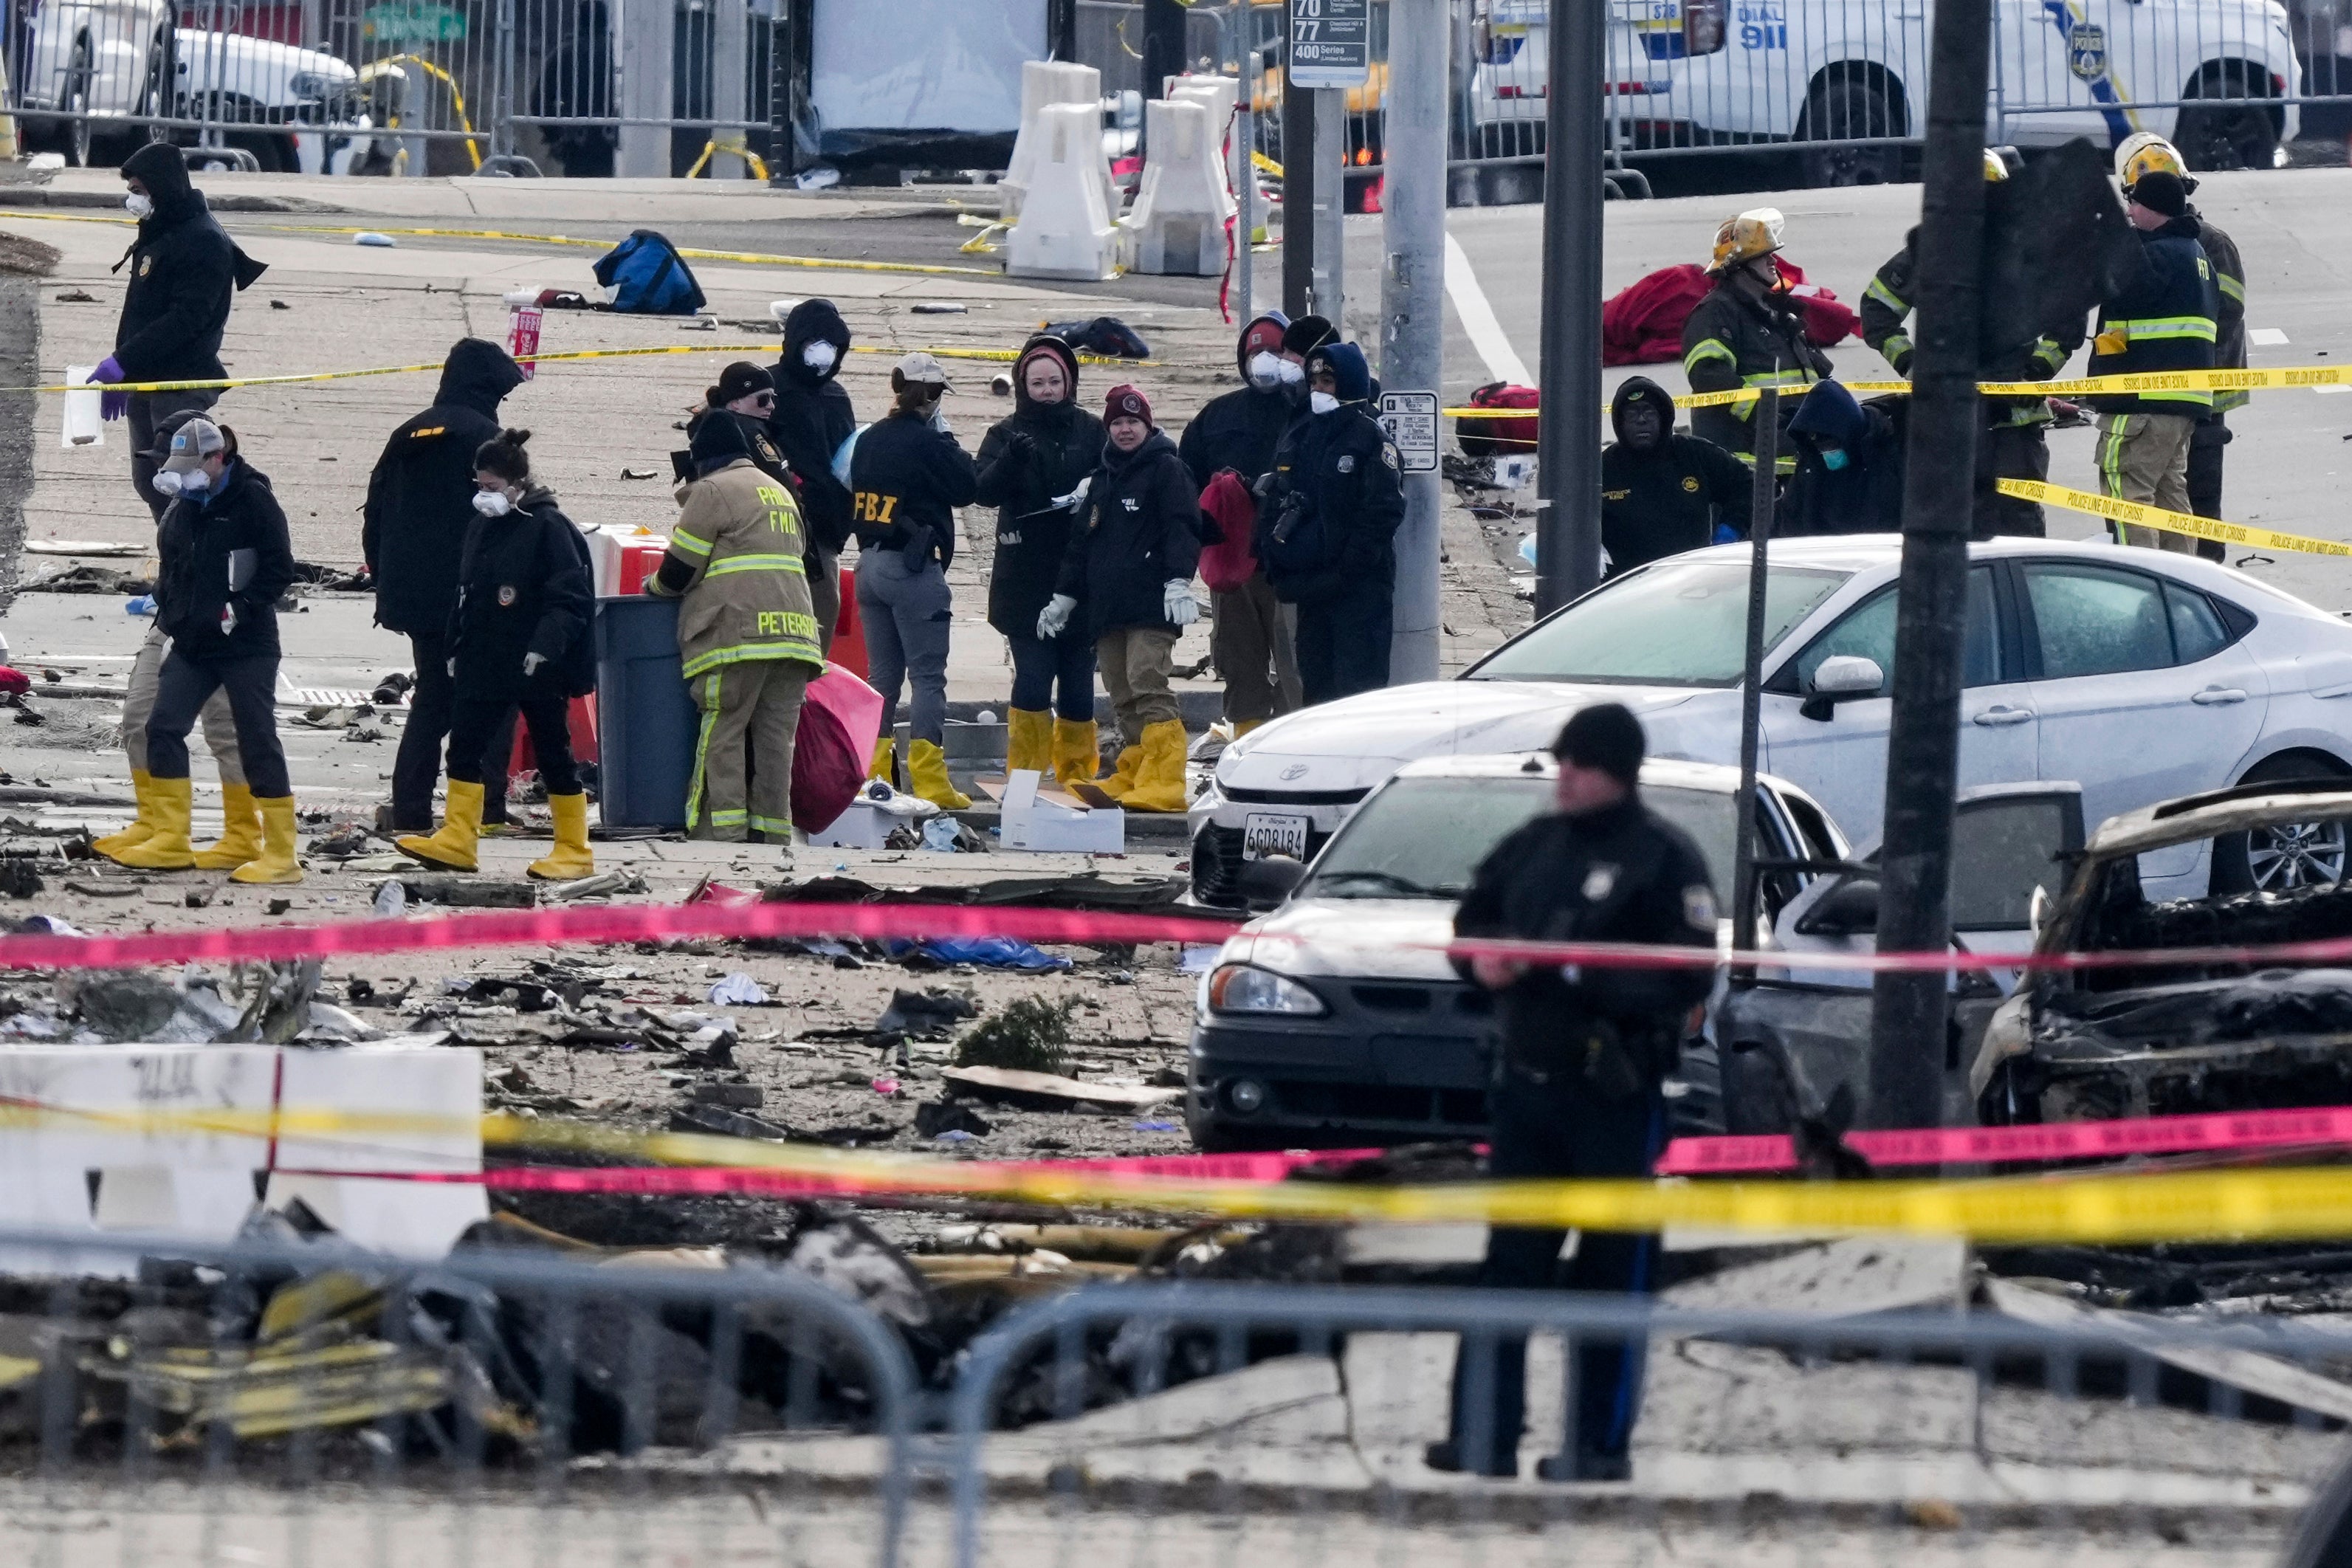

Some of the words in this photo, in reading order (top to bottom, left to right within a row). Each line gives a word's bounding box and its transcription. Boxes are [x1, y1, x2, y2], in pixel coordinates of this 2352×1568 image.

[1296, 0, 1321, 16] 70
[1295, 20, 1320, 41] 77
[1741, 25, 1786, 49] 911
[1296, 45, 1319, 58] 400
[1320, 45, 1344, 54] Series
[2196, 257, 2209, 281] PFD
[2123, 377, 2141, 390] CROSS
[2142, 376, 2152, 389] NOT
[2153, 376, 2160, 389] DO
[2161, 376, 2171, 389] LINE
[2171, 374, 2189, 388] POLICE
[2208, 374, 2224, 387] CROSS
[2224, 374, 2233, 387] NOT
[2235, 374, 2241, 386] DO
[2242, 373, 2252, 386] LINE
[2252, 372, 2268, 386] POLICE
[2026, 482, 2046, 498] CROSS
[853, 492, 898, 524] FBI
[2067, 492, 2088, 509] POLICE
[2088, 497, 2102, 512] LINE
[2102, 501, 2111, 513] DO
[2111, 503, 2124, 517] NOT
[2124, 504, 2144, 520] CROSS
[2167, 515, 2188, 531] POLICE
[2189, 519, 2202, 534] LINE
[2204, 523, 2212, 535] DO
[2215, 524, 2227, 537] NOT
[2227, 526, 2246, 541] CROSS
[2270, 534, 2291, 549] POLICE
[2291, 537, 2305, 551] LINE
[2306, 541, 2314, 553] DO
[2316, 542, 2328, 554] NOT
[2328, 543, 2349, 555] CROSS
[1248, 828, 1301, 853] 6GD8184
